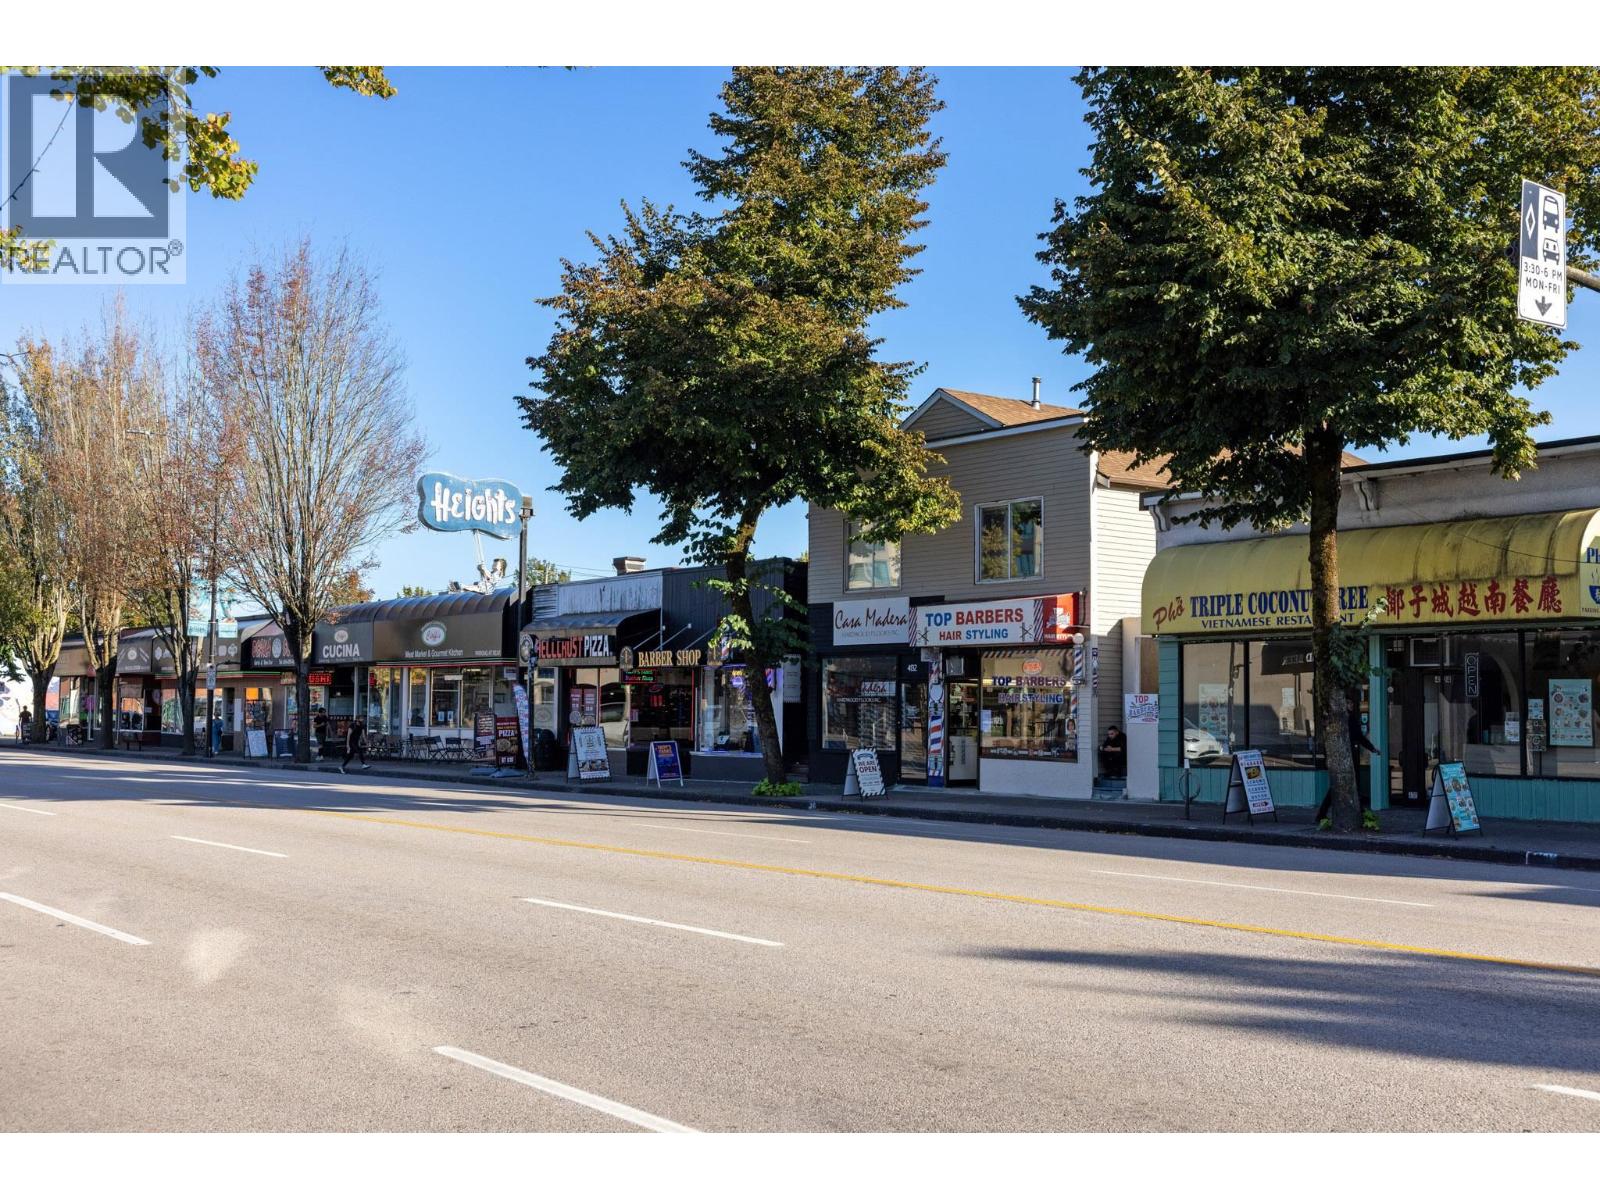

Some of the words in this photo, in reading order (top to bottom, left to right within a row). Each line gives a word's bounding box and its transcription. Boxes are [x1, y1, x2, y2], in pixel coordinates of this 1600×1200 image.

[1523, 262, 1549, 278] 3:30-6
[1551, 269, 1563, 282] PM
[1525, 277, 1561, 294] MON-FRI
[431, 482, 516, 525] Heights
[1190, 593, 1244, 618] TRIPLE
[1248, 589, 1313, 615] COCONU
[1338, 585, 1369, 611] REE
[835, 609, 862, 630] Casa
[865, 607, 908, 628] Madera
[925, 612, 952, 627] TOP
[956, 607, 1024, 626] BARBERS
[1201, 616, 1272, 629] VIETNAMESE
[1276, 613, 1355, 627] RESTANT
[939, 630, 962, 641] HAIR
[965, 628, 1009, 640] STYLING
[322, 643, 360, 658] CUCINA
[638, 651, 674, 667] BARBER
[676, 649, 702, 666] SHOP
[991, 675, 1012, 686] TOP
[1015, 675, 1067, 688] BARBERS
[1022, 693, 1064, 703] STYLING
[1134, 695, 1149, 704] TOP
